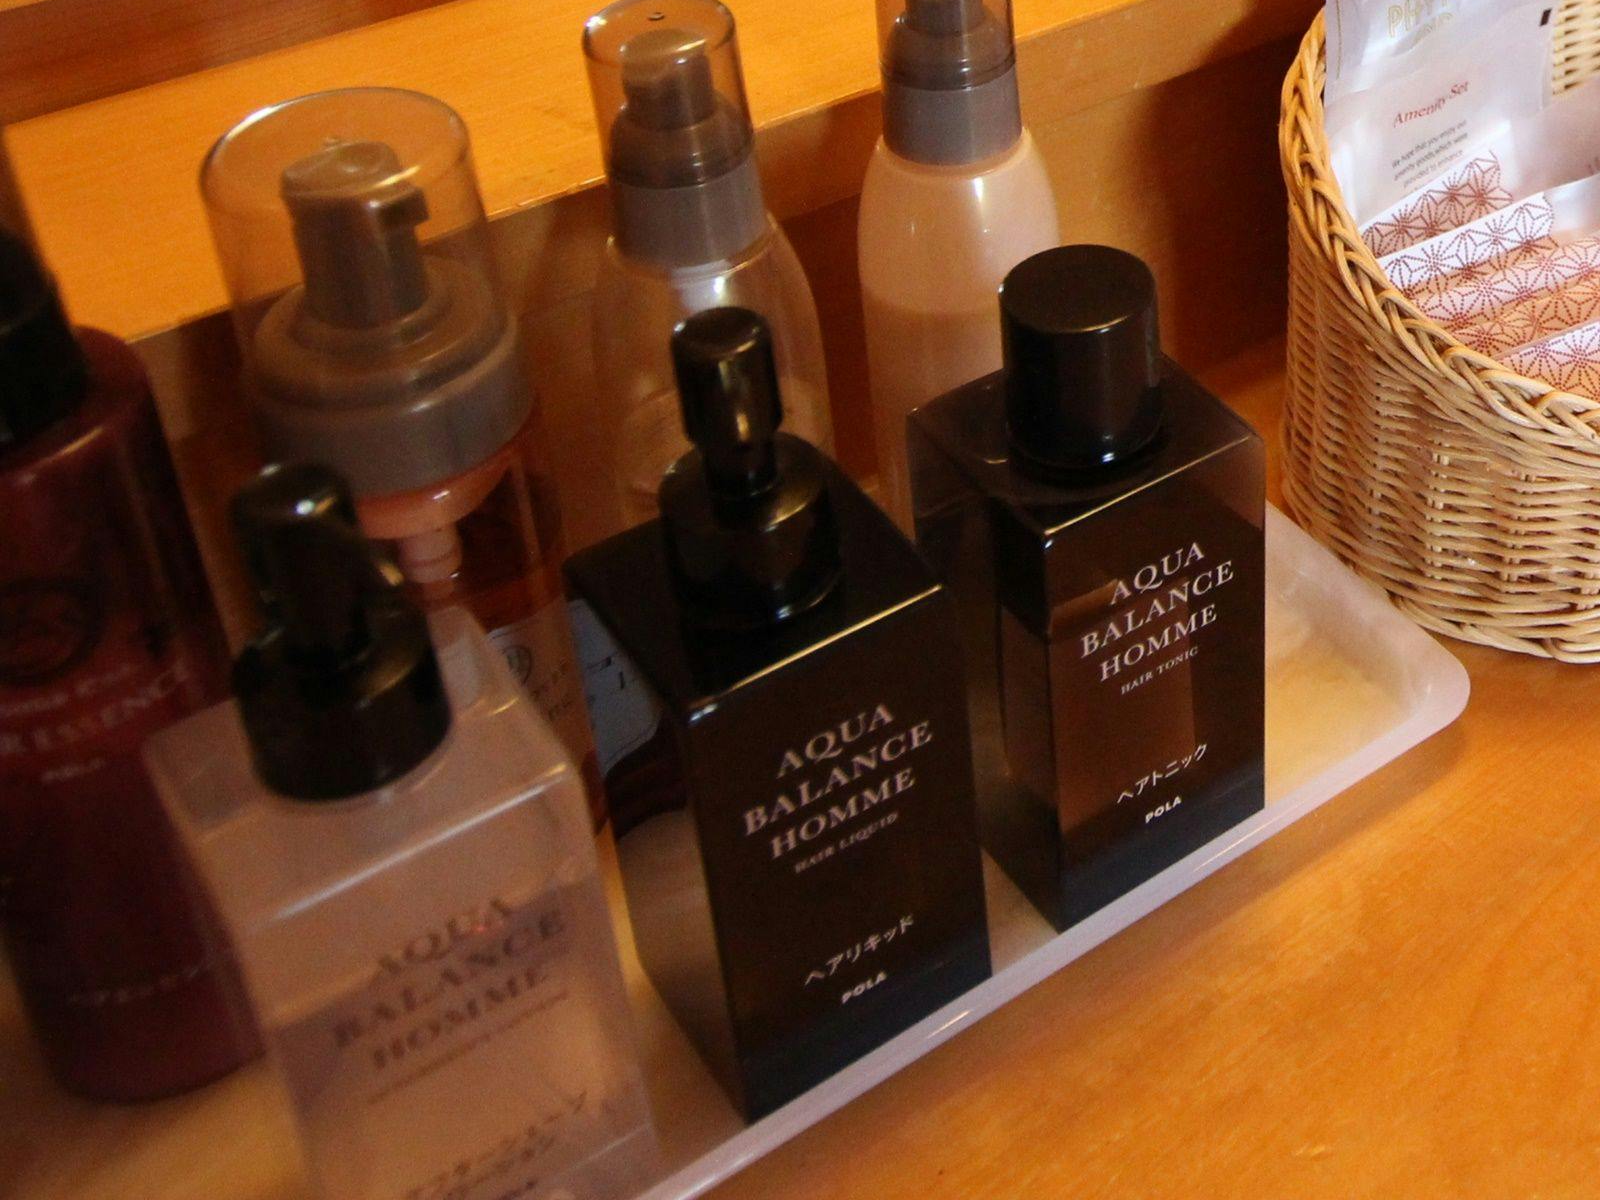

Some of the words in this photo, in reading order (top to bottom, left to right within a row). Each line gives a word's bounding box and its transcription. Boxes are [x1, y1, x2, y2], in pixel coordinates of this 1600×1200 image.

[1393, 97, 1446, 128] Amenity
[1447, 81, 1469, 99] Set
[1109, 542, 1205, 605] AQUA
[1080, 560, 1234, 658] BALANCE
[1100, 604, 1217, 682] HOMME
[1120, 671, 1154, 695] HAIR
[1156, 646, 1199, 674] TONIC
[776, 703, 896, 780] AQUA
[1117, 743, 1207, 804] ヘアトニック
[743, 720, 934, 837] BALANCE
[1145, 795, 1182, 824] POLA
[770, 767, 917, 860] HOMME
[804, 914, 914, 987] ヘアリキッド
[841, 970, 887, 1004] POLA
